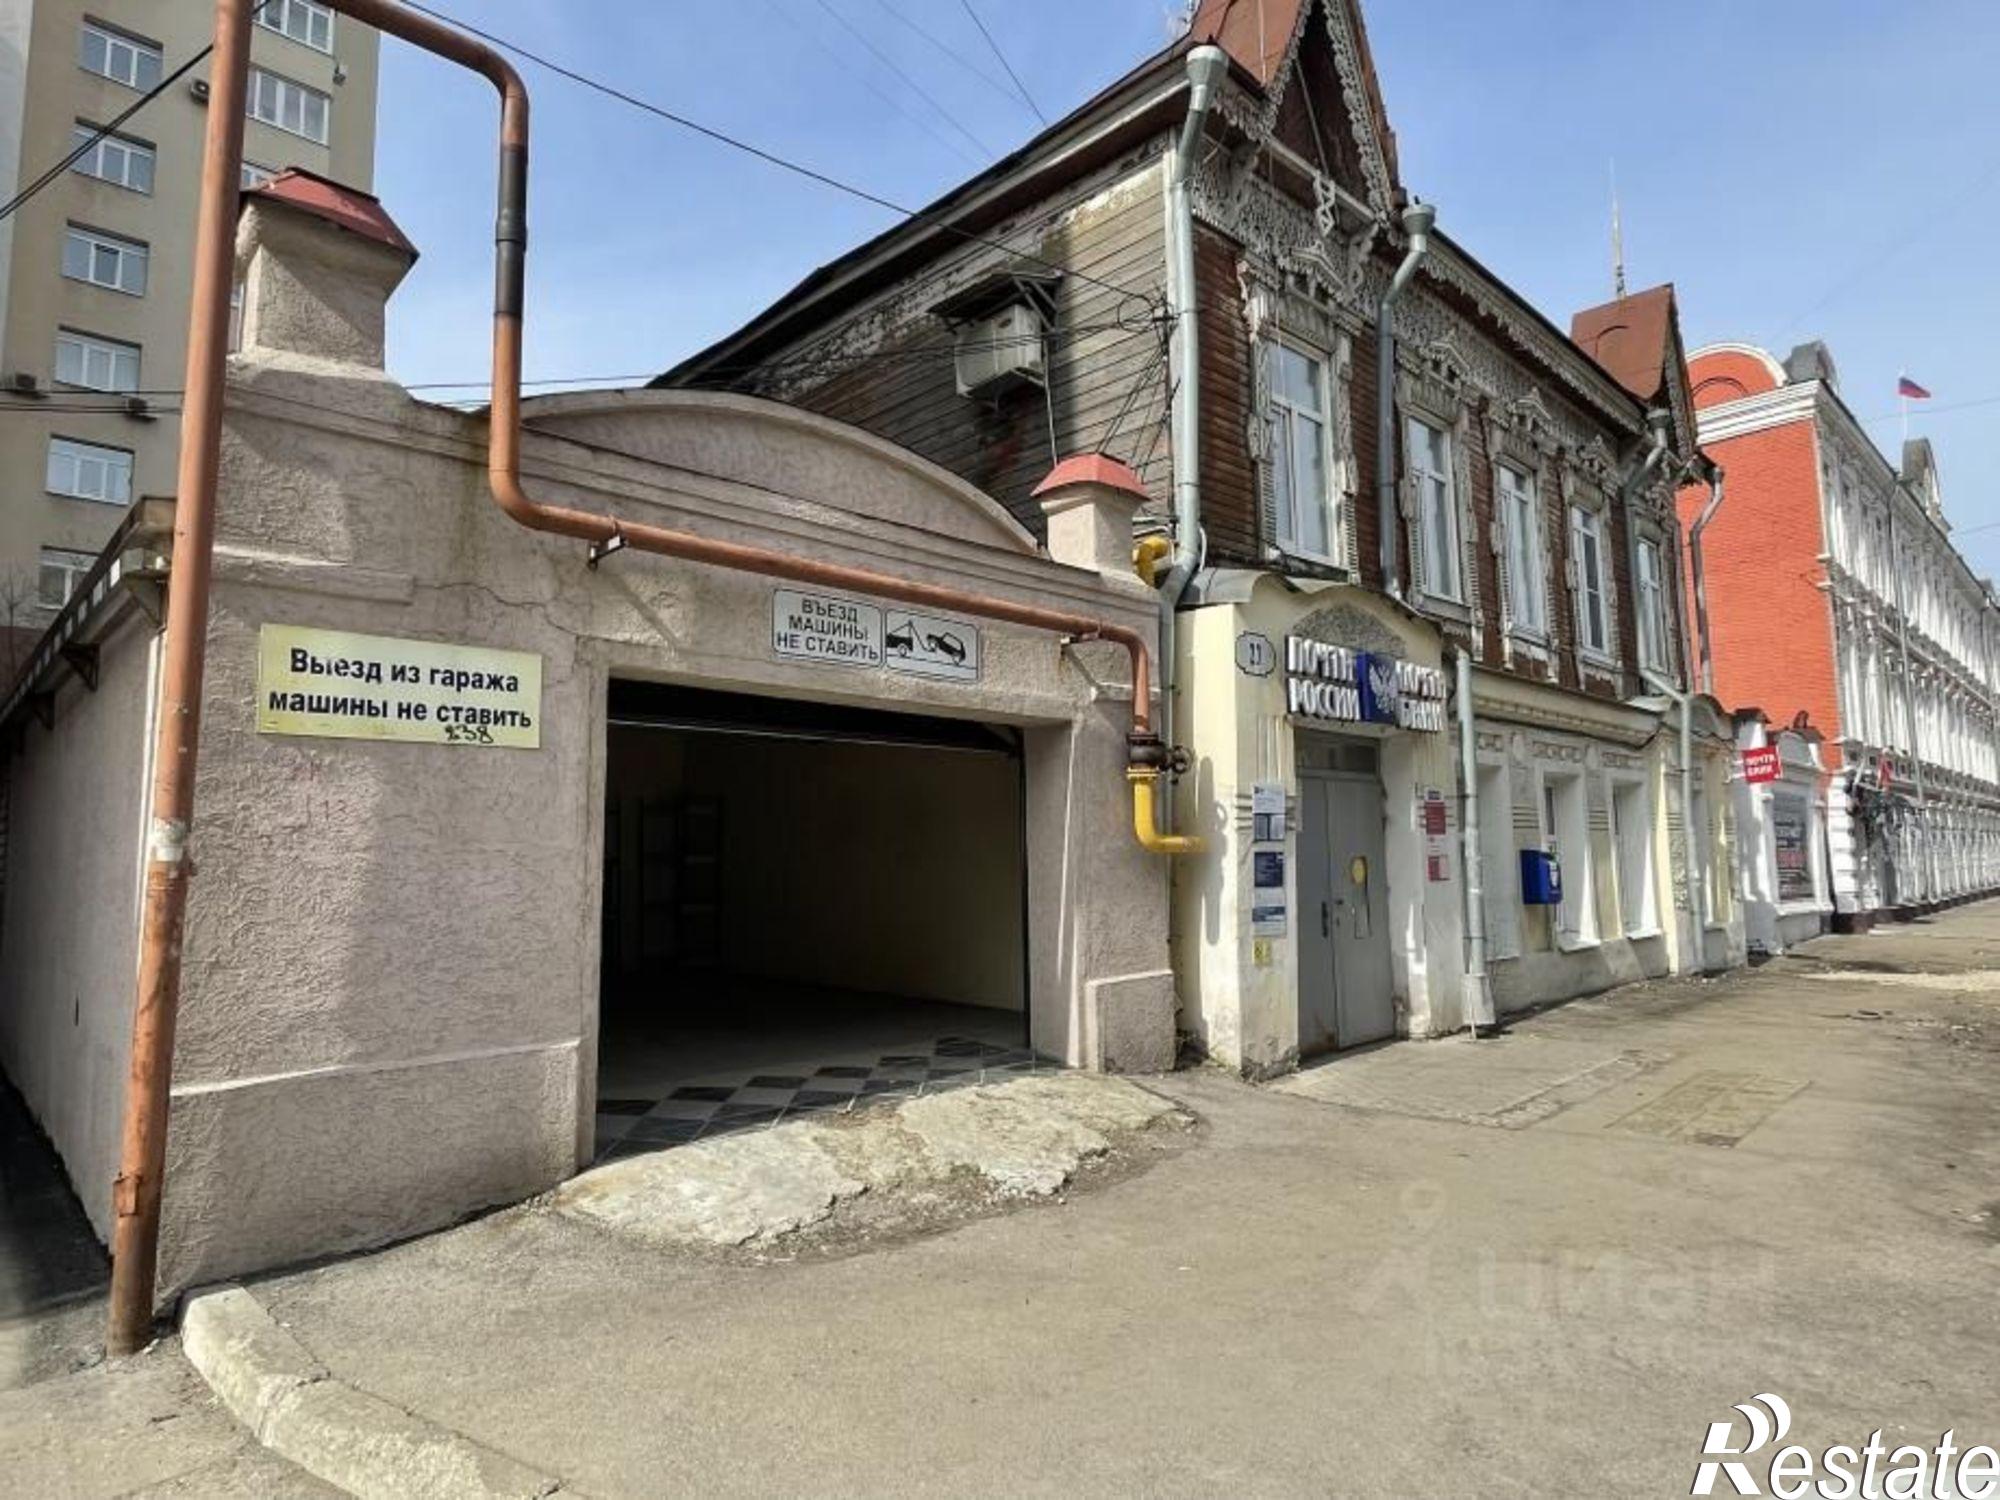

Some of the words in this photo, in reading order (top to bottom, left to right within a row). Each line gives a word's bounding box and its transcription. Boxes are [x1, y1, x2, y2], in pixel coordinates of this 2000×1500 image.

[801, 598, 858, 622] ВЪЕЗД
[788, 614, 868, 640] МАШИНЫ
[776, 632, 800, 649] НЕ
[805, 636, 879, 660] СТАВИТЬ
[290, 647, 381, 684] Выезд
[391, 663, 420, 683] из
[430, 667, 519, 693] гаража
[268, 690, 388, 719] машины
[397, 701, 428, 721] не
[436, 704, 532, 728] ставить
[1288, 677, 1361, 720] РОССИИ
